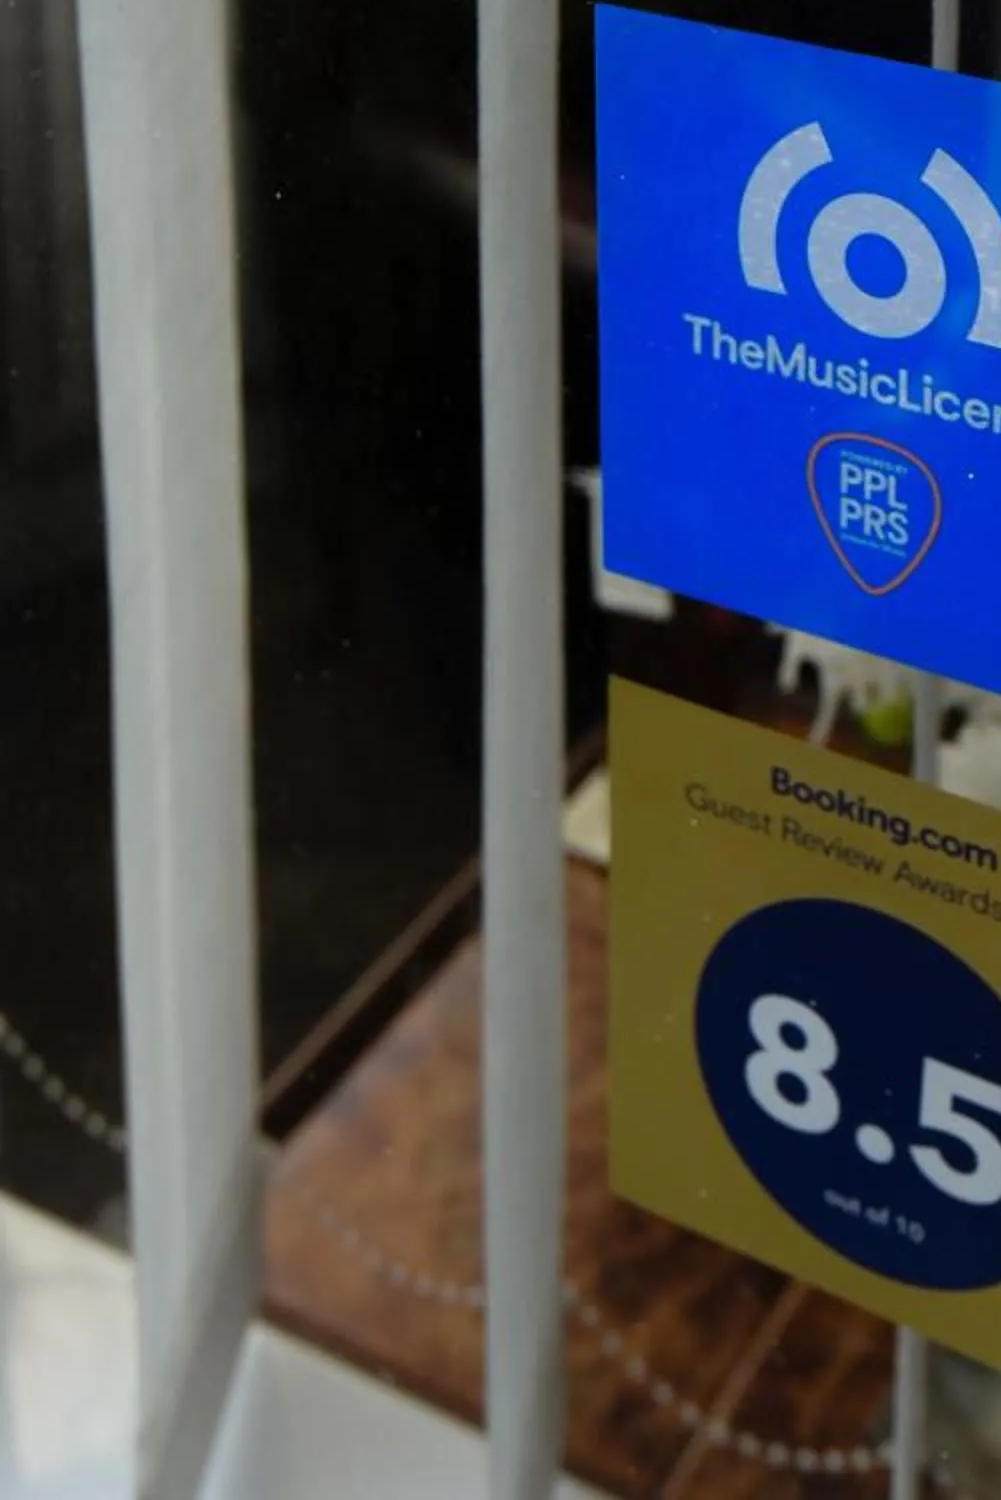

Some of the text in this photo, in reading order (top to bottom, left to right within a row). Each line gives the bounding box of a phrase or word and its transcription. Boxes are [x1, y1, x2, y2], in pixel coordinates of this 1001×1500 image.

[839, 461, 909, 512] PPL
[839, 496, 910, 546] PRS
[684, 781, 774, 837] Guest
[780, 815, 886, 877] Review
[769, 765, 999, 872] Booking.com
[823, 1188, 861, 1217] out
[864, 1205, 890, 1226] of
